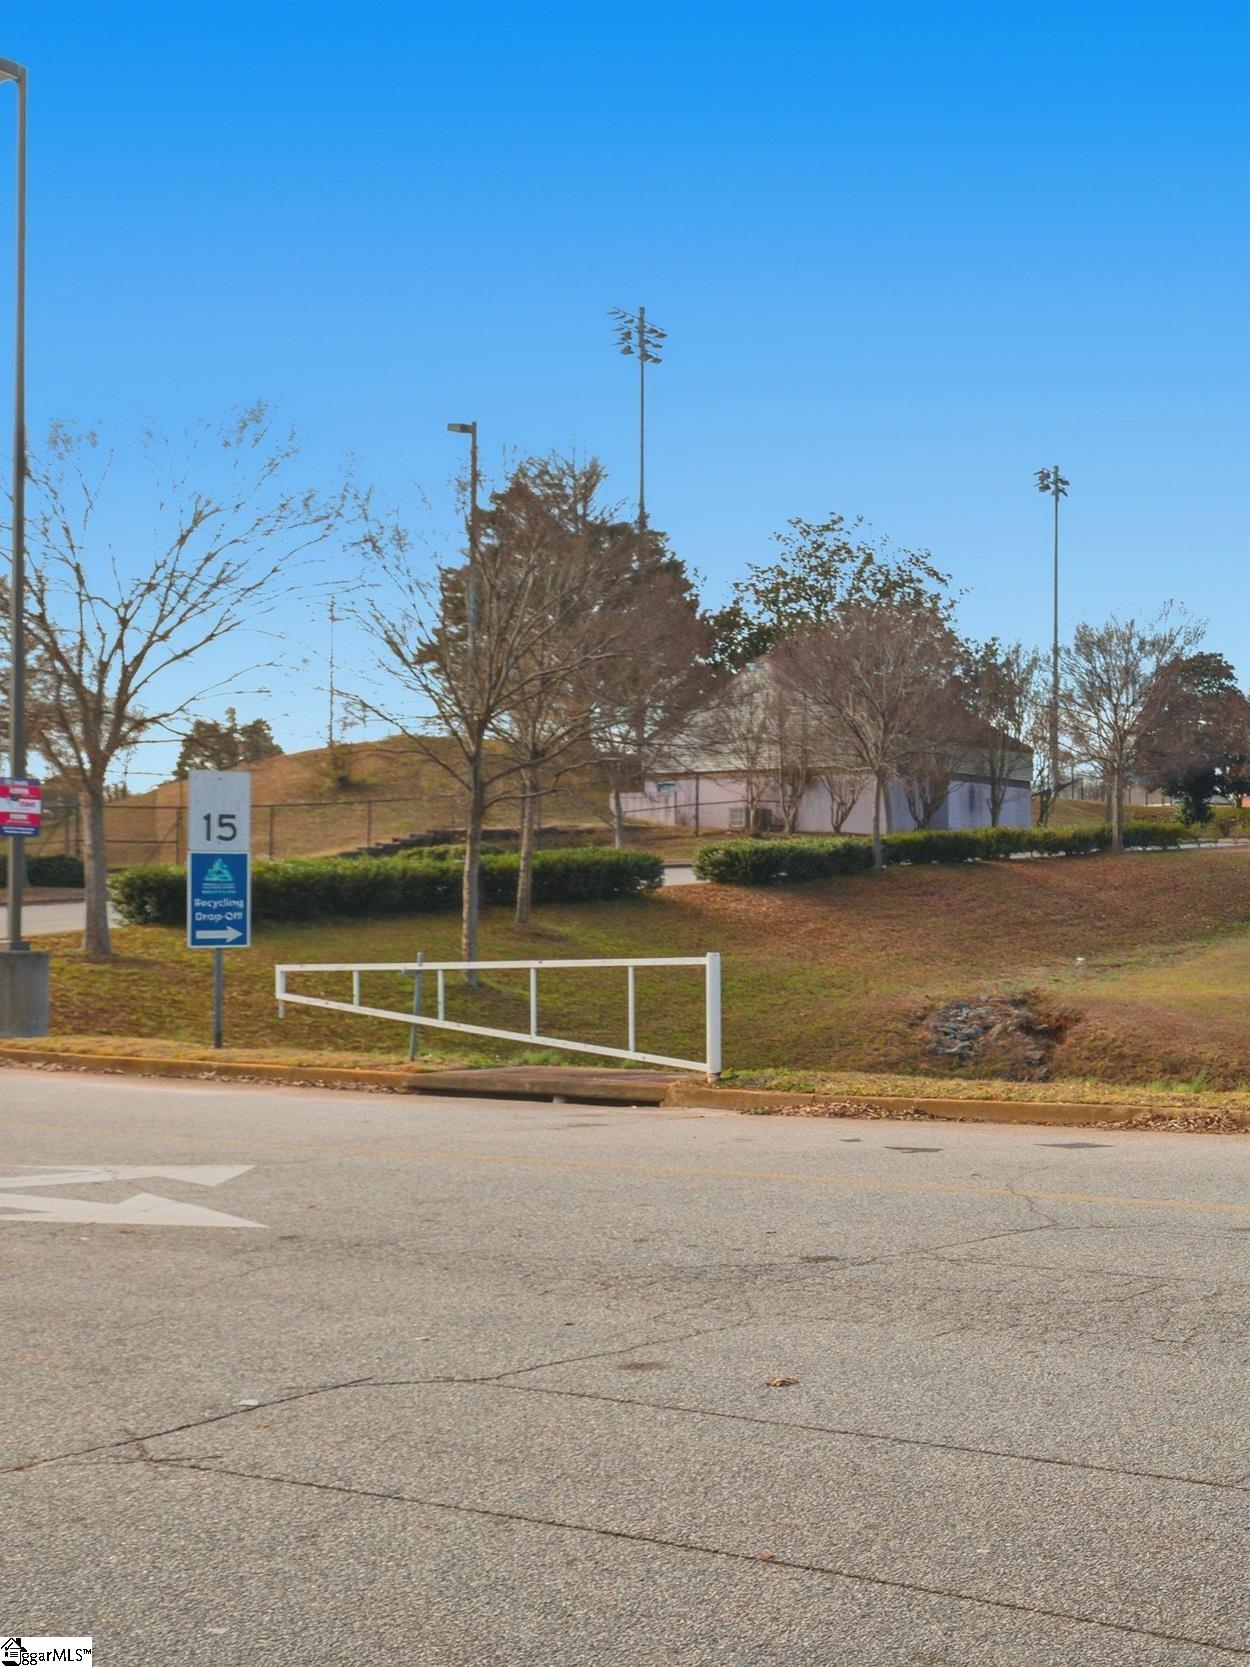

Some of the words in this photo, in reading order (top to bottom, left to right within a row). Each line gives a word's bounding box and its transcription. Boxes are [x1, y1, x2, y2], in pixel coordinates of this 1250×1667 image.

[203, 812, 238, 842] 15
[194, 898, 244, 909] Recycling
[195, 912, 243, 923] Drop-Off
